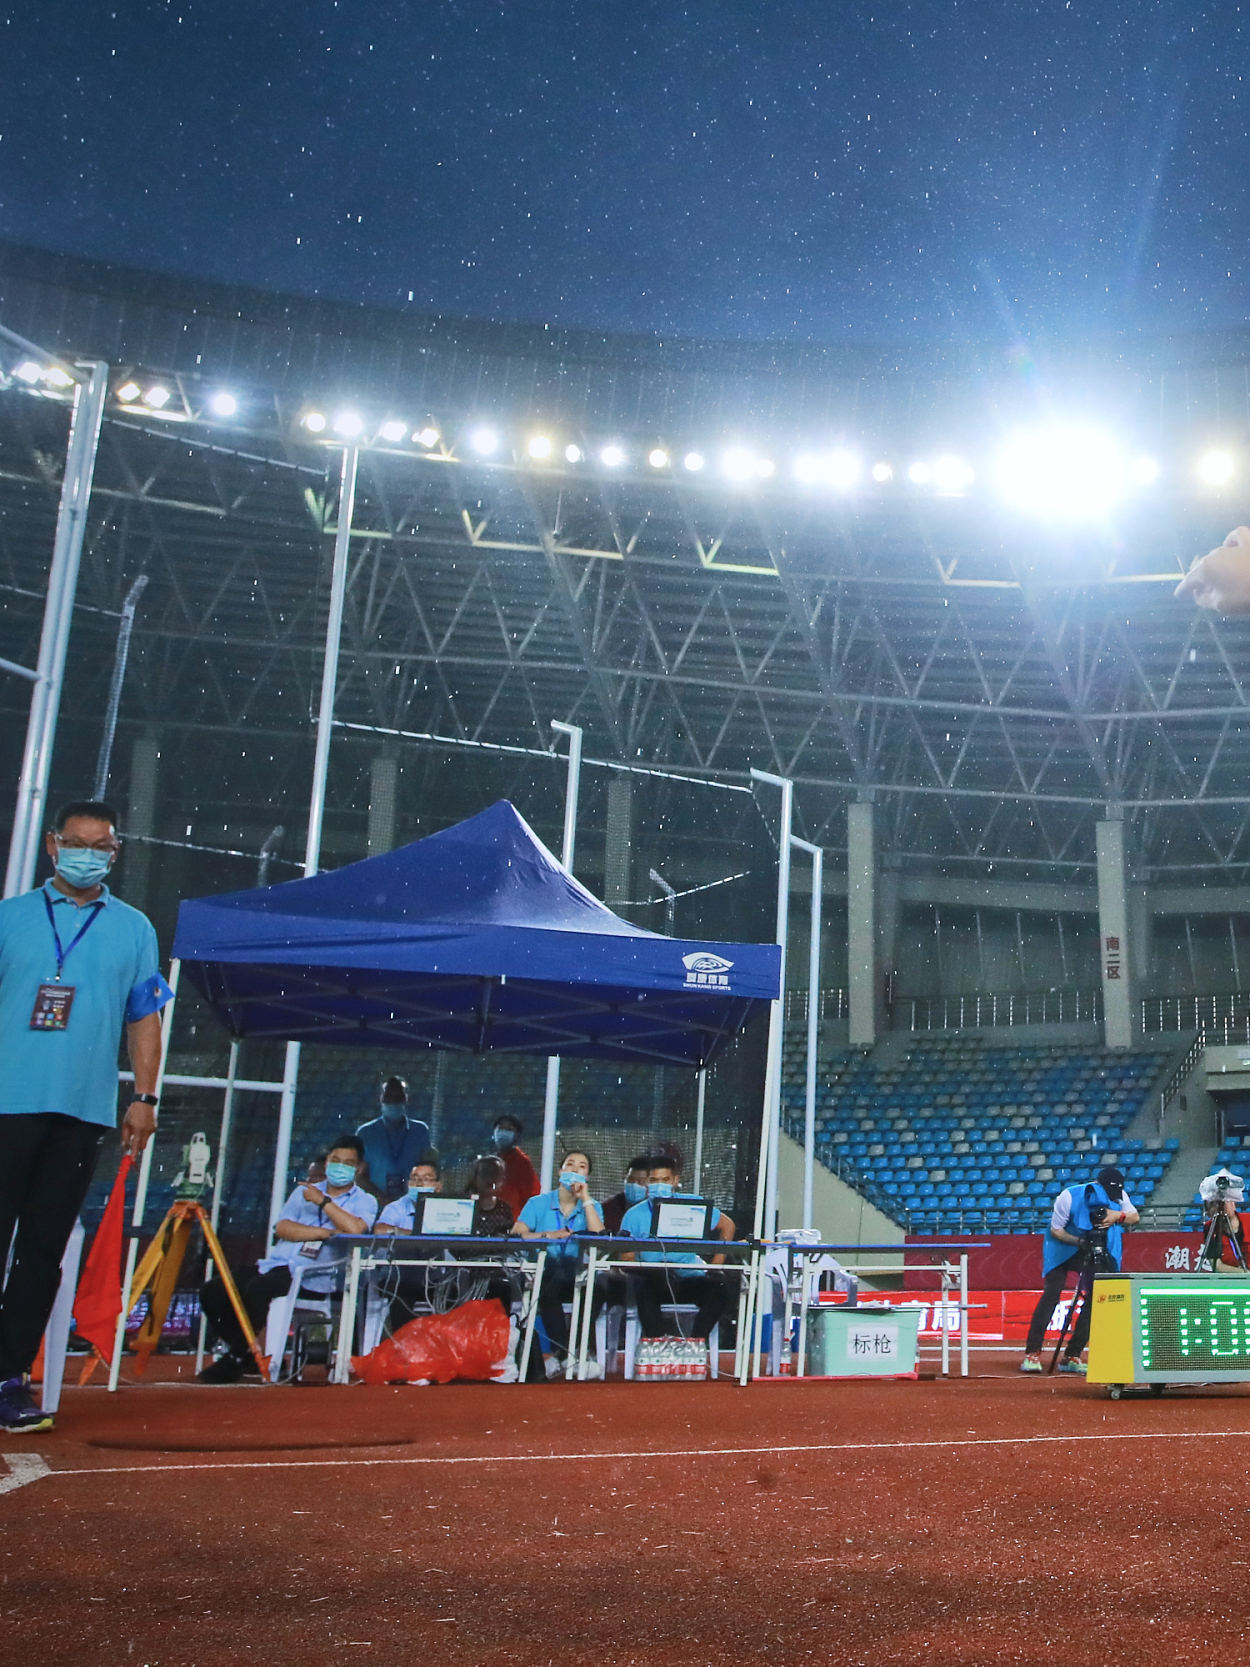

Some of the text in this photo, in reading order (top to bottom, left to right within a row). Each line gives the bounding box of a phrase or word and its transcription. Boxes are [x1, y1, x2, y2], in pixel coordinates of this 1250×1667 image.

[1106, 936, 1120, 979] 南二区
[853, 1333, 892, 1355] 标枪
